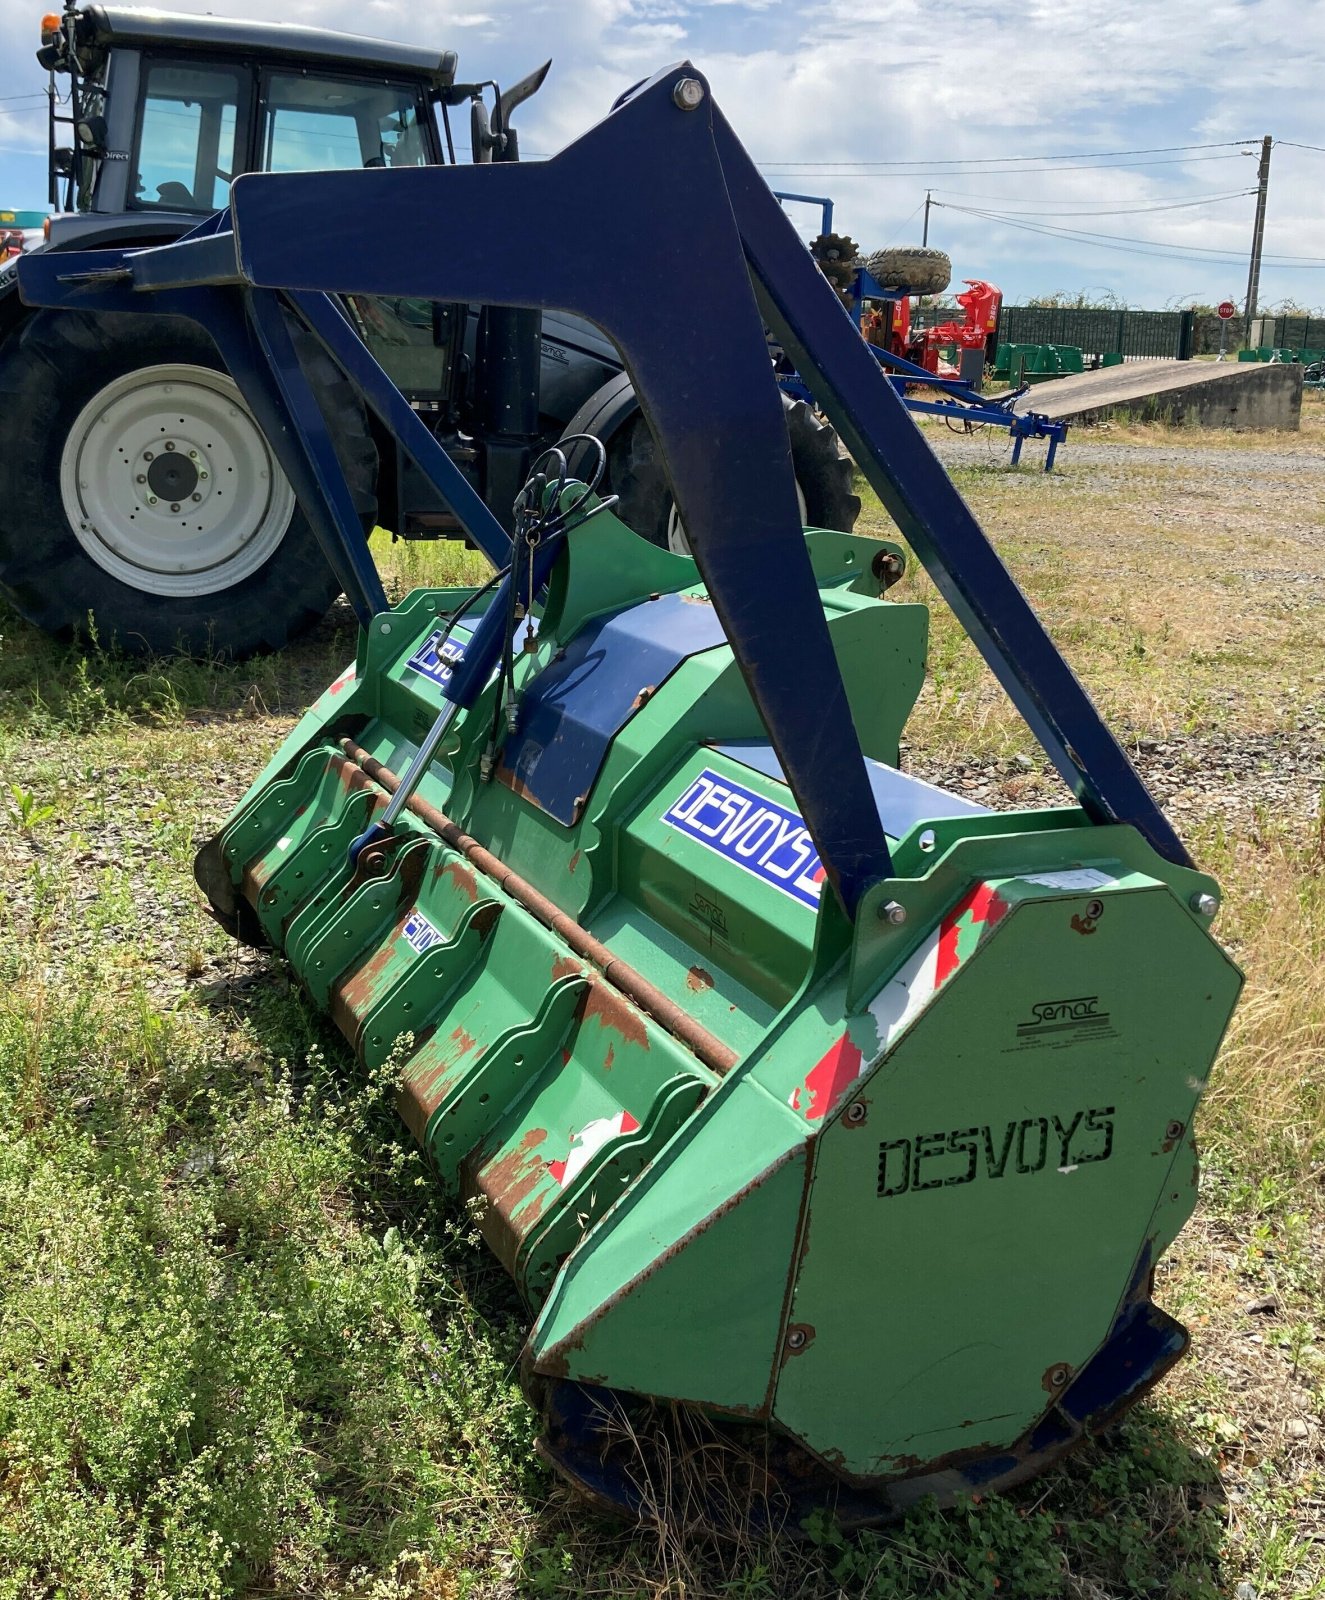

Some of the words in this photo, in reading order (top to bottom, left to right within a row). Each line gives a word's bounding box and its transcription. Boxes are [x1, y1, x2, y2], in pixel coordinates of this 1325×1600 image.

[669, 776, 817, 880] DESVOYS
[1026, 996, 1103, 1026] Semac
[877, 1106, 1116, 1198] DESVOYS
